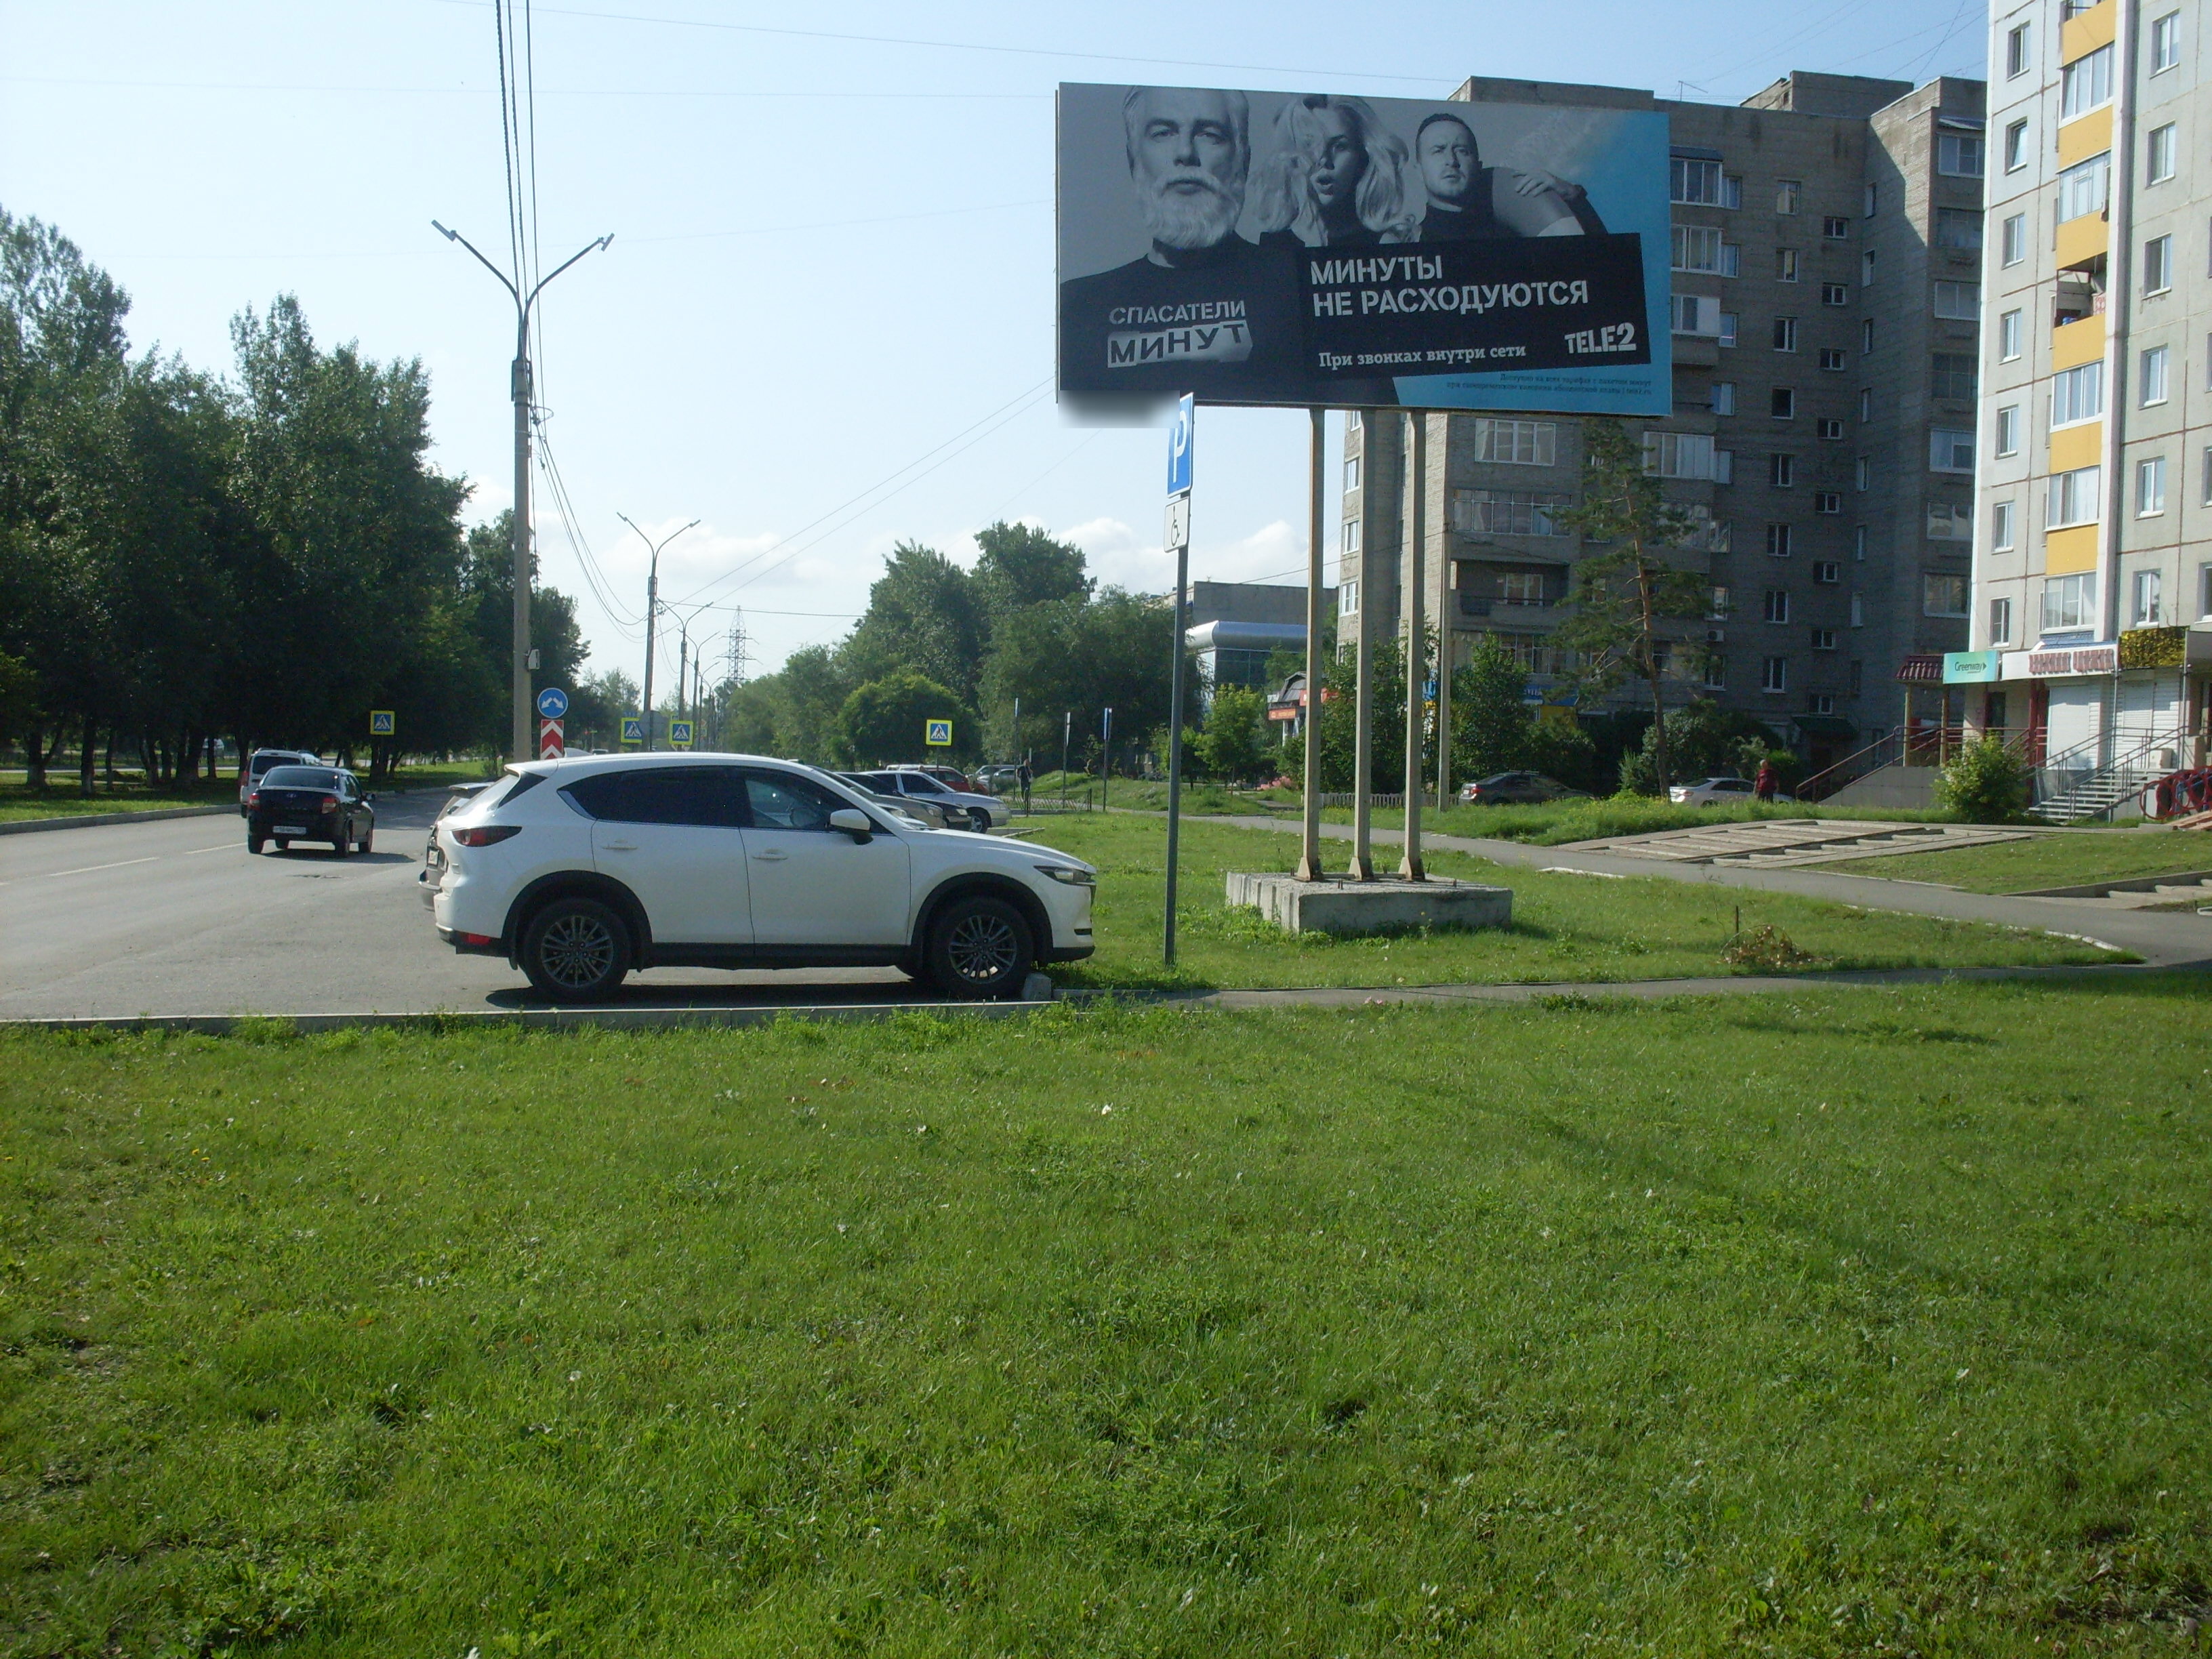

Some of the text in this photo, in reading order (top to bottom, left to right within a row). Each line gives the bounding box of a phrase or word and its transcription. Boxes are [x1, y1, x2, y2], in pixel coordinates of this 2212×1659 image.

[1311, 255, 1442, 285] МИНУТЫ
[1109, 300, 1246, 325] СПАСАТЕЛИ
[1313, 280, 1589, 316] НЕ РАСХОДУЮТСЯ
[1110, 323, 1244, 364] МИНУТ
[1564, 322, 1637, 354] TELE2
[1319, 346, 1526, 371] При звонках внутри сети
[1954, 661, 1983, 672] Greenway
